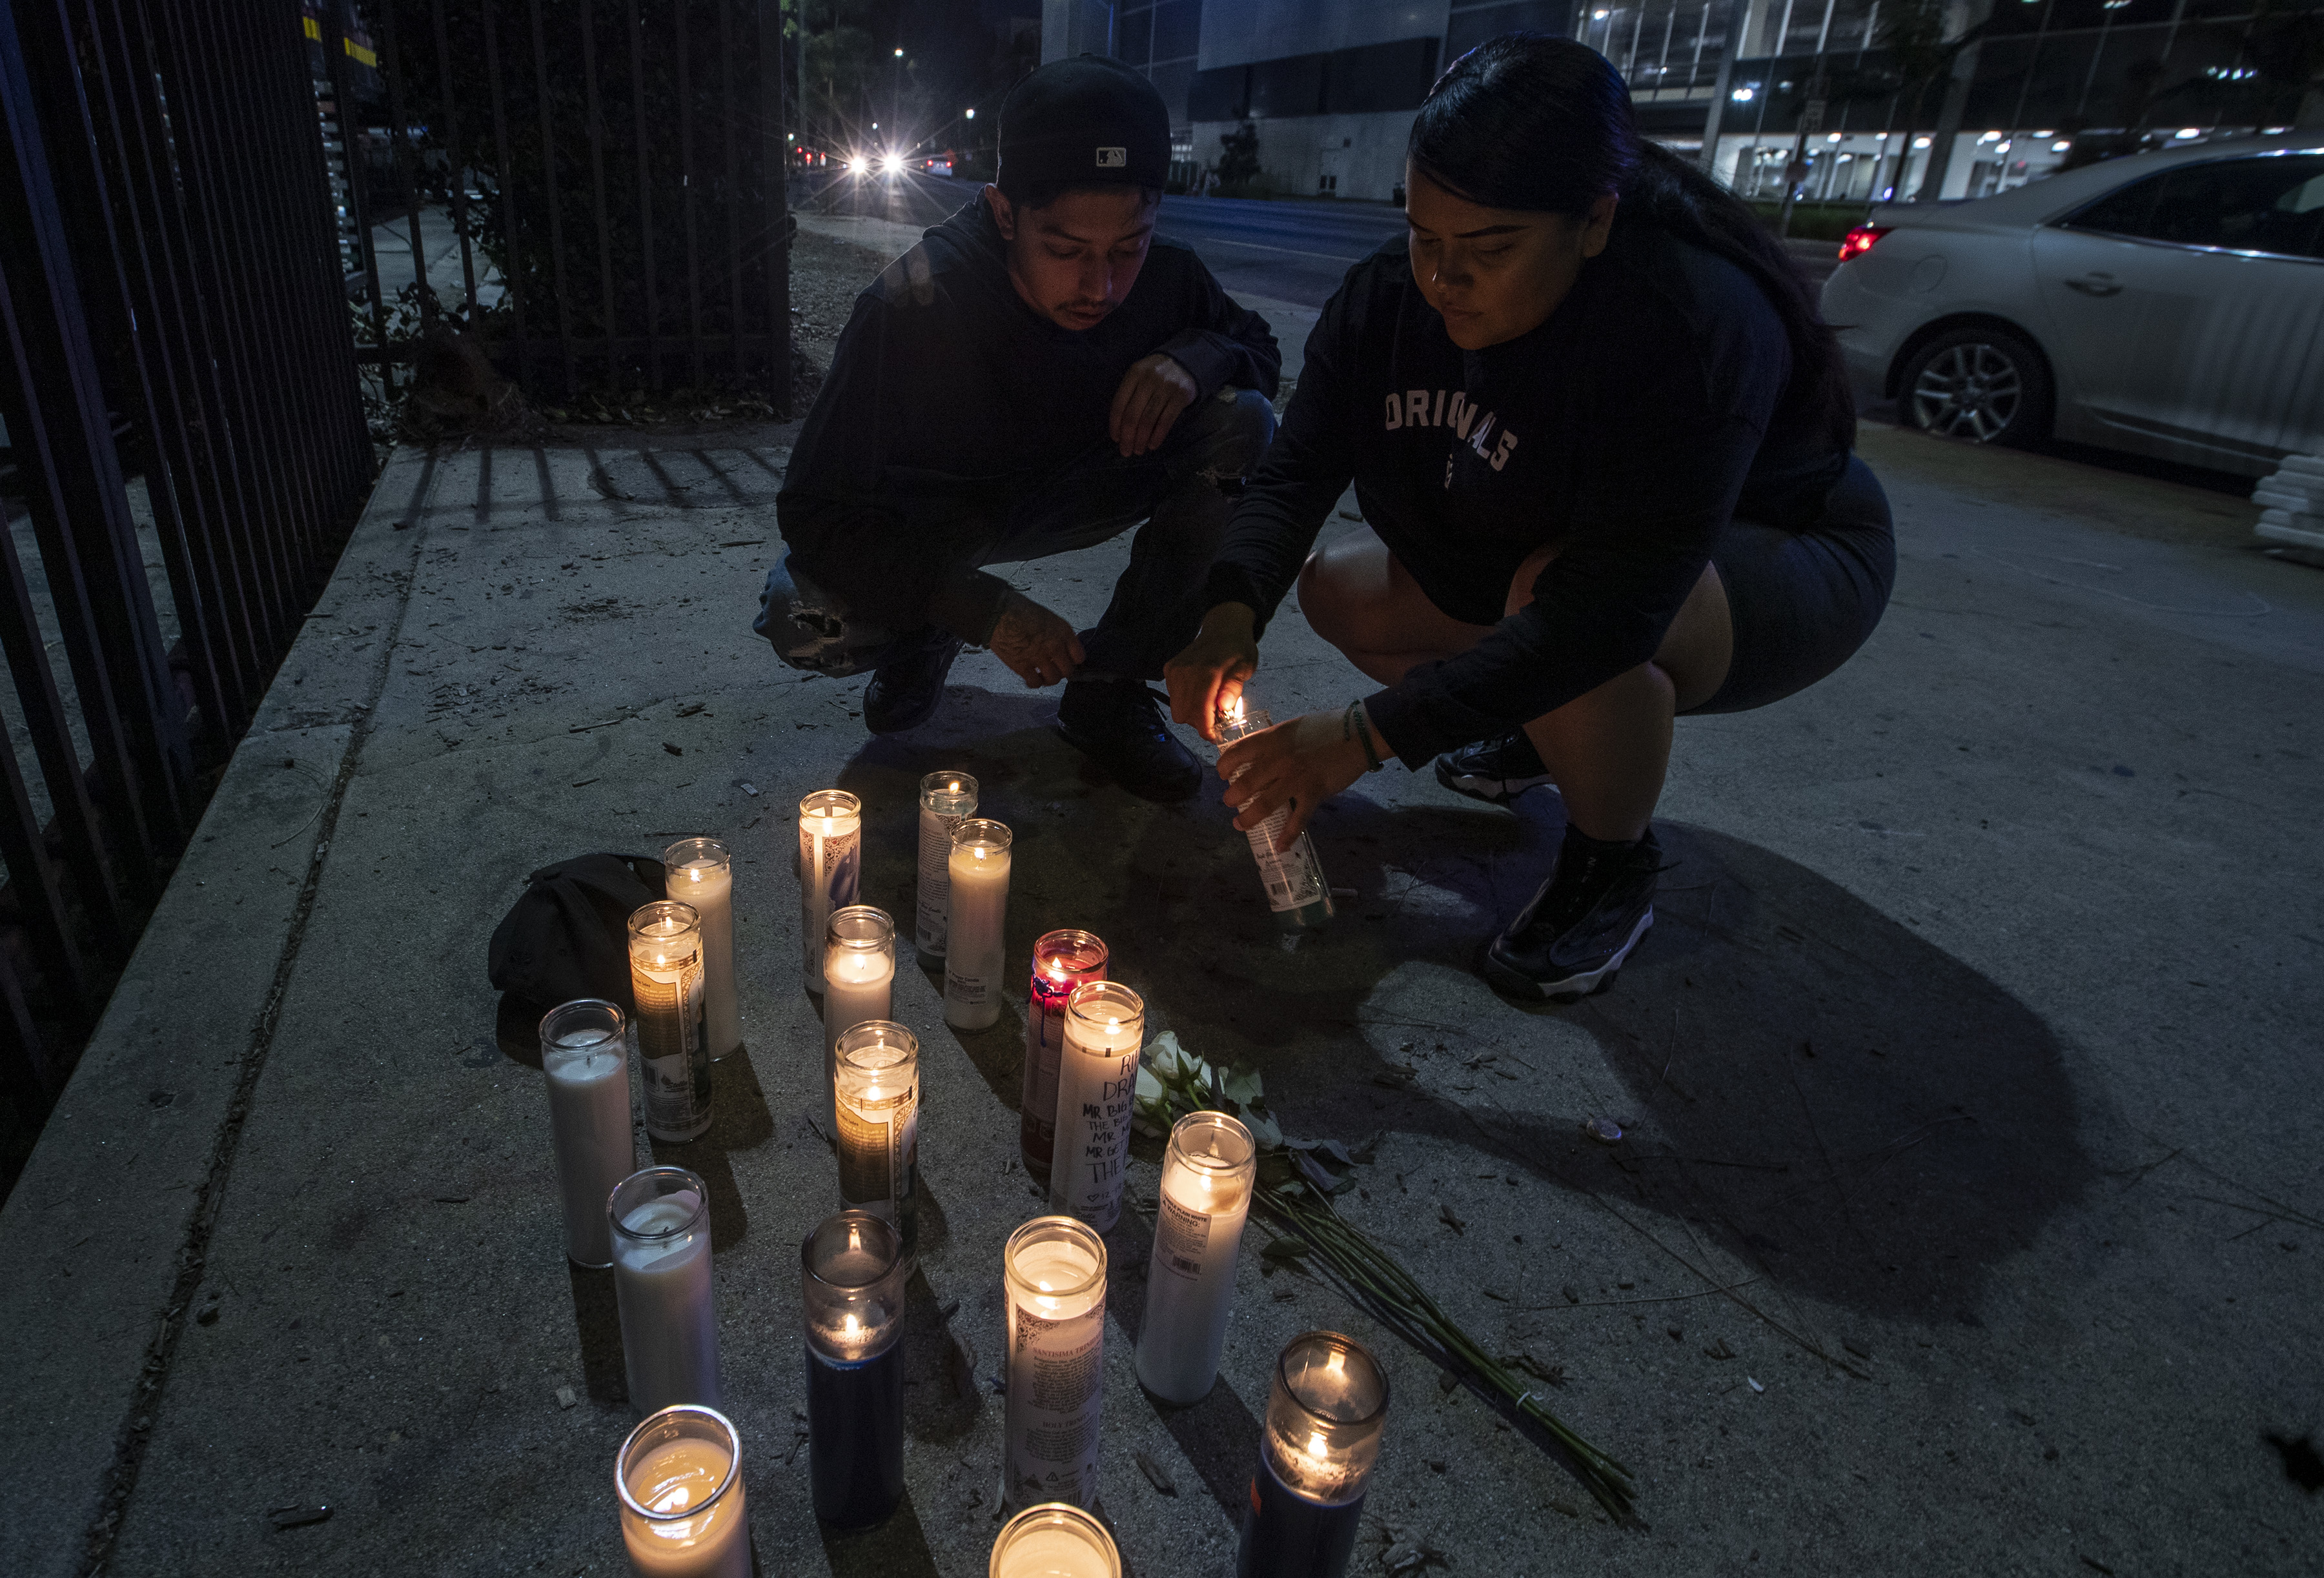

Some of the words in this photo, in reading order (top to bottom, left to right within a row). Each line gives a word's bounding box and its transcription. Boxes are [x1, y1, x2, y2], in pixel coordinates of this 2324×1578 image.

[1103, 1073, 1135, 1101] DRA
[1106, 1101, 1127, 1117] BIG
[1086, 1120, 1109, 1131] THE
[1086, 1156, 1121, 1183] THE
[1167, 1204, 1200, 1228] WARNING:
[1177, 1208, 1190, 1217] PLAIN
[1191, 1214, 1207, 1222] WHITE
